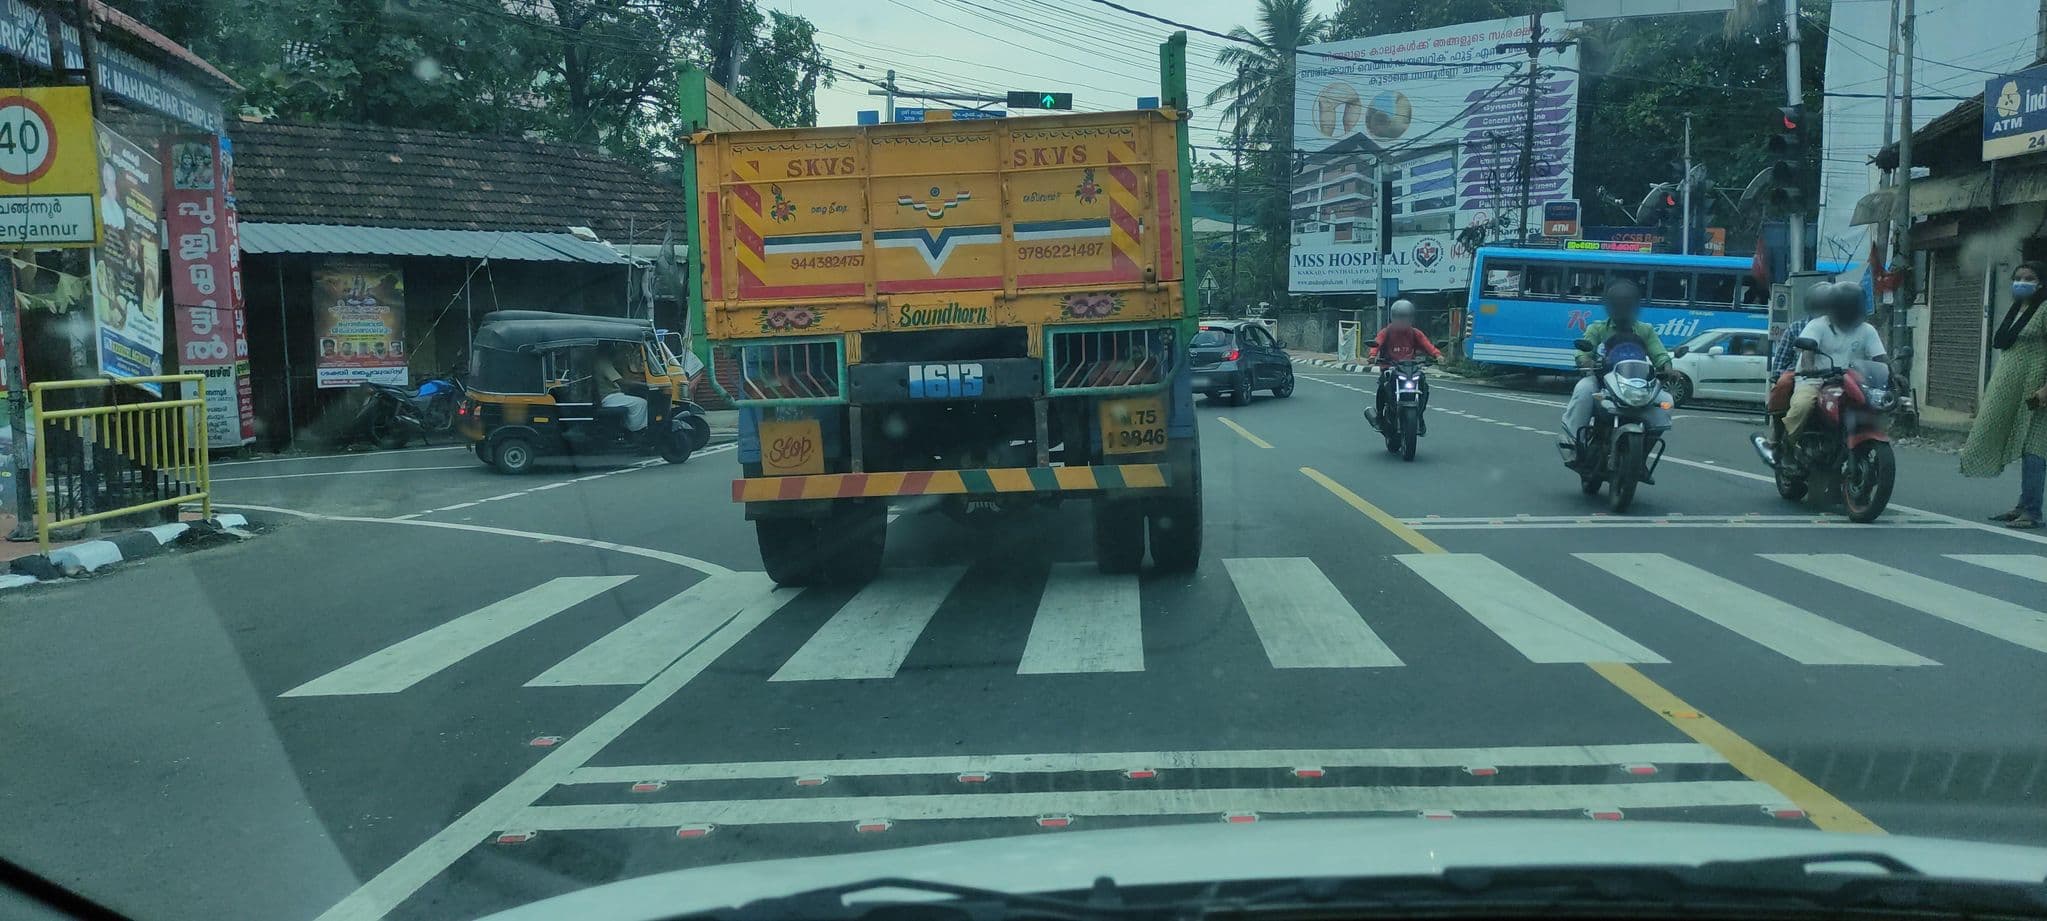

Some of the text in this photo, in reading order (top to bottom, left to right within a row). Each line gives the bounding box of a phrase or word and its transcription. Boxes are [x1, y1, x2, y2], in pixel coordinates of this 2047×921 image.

[114, 69, 181, 120] MAHADEVAR
[180, 100, 214, 132] TEMPLE
[1991, 116, 2023, 134] ATM
[0, 119, 40, 155] 40
[2028, 134, 2046, 149] 24
[1551, 223, 1570, 232] ATM
[1018, 242, 1104, 260] 9786221487
[1292, 252, 1325, 268] MSS
[1329, 250, 1411, 268] HOSPITAL
[791, 255, 865, 270] 9443824757
[900, 302, 987, 327] Soundhorn
[909, 363, 983, 398] 1613
